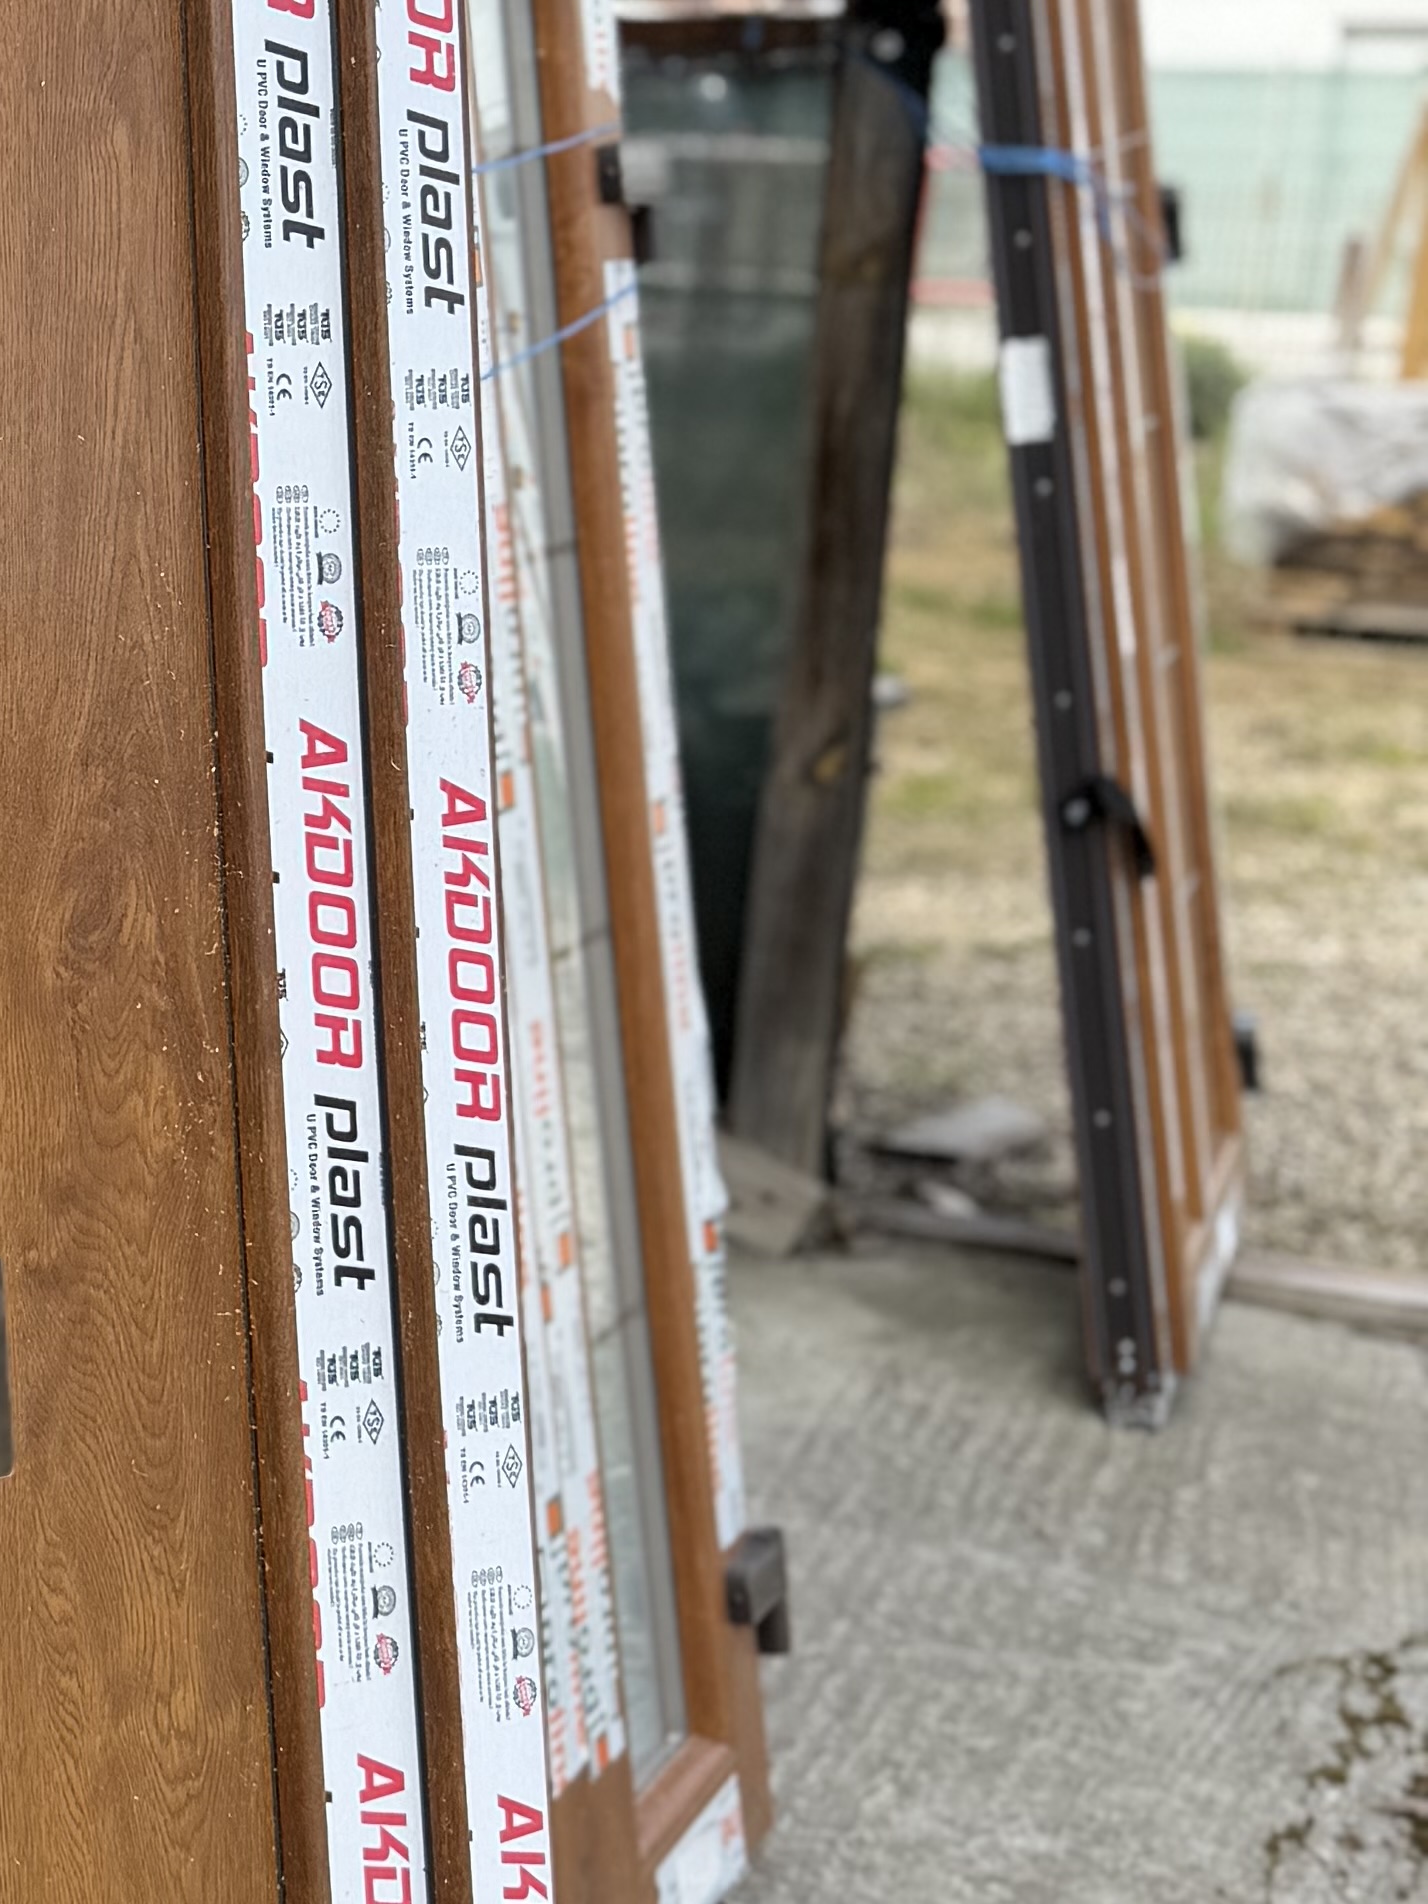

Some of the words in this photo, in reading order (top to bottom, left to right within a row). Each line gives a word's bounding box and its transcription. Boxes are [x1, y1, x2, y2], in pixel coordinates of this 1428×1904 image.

[265, 40, 324, 248] plast
[407, 108, 465, 314] plast
[298, 719, 364, 1070] AKDOOR
[439, 779, 502, 1123] AKDOOR
[315, 1095, 374, 1290] plast
[455, 1145, 513, 1336] plast
